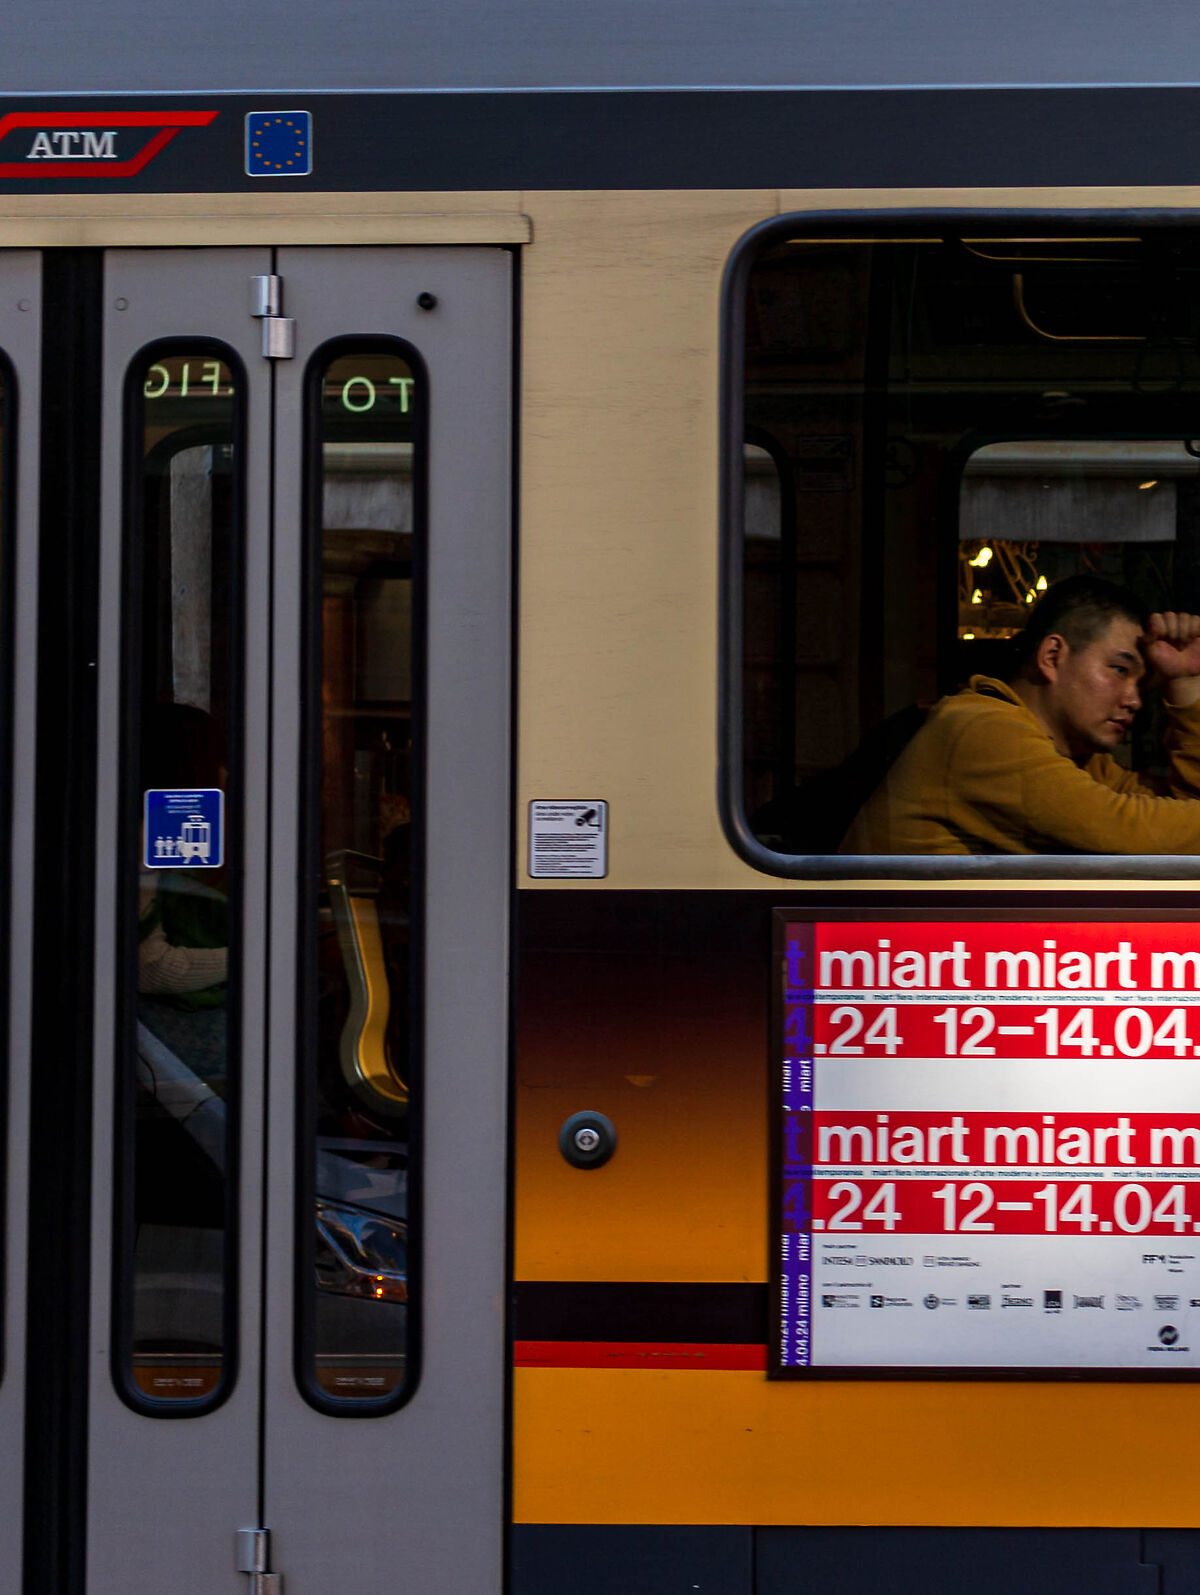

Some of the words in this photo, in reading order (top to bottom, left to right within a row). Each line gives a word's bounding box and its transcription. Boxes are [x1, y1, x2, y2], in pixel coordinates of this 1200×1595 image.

[27, 131, 118, 159] ATM
[820, 940, 972, 988] miart
[985, 940, 1138, 988] miart
[817, 1115, 970, 1163] miart
[984, 1116, 1137, 1164] miart
